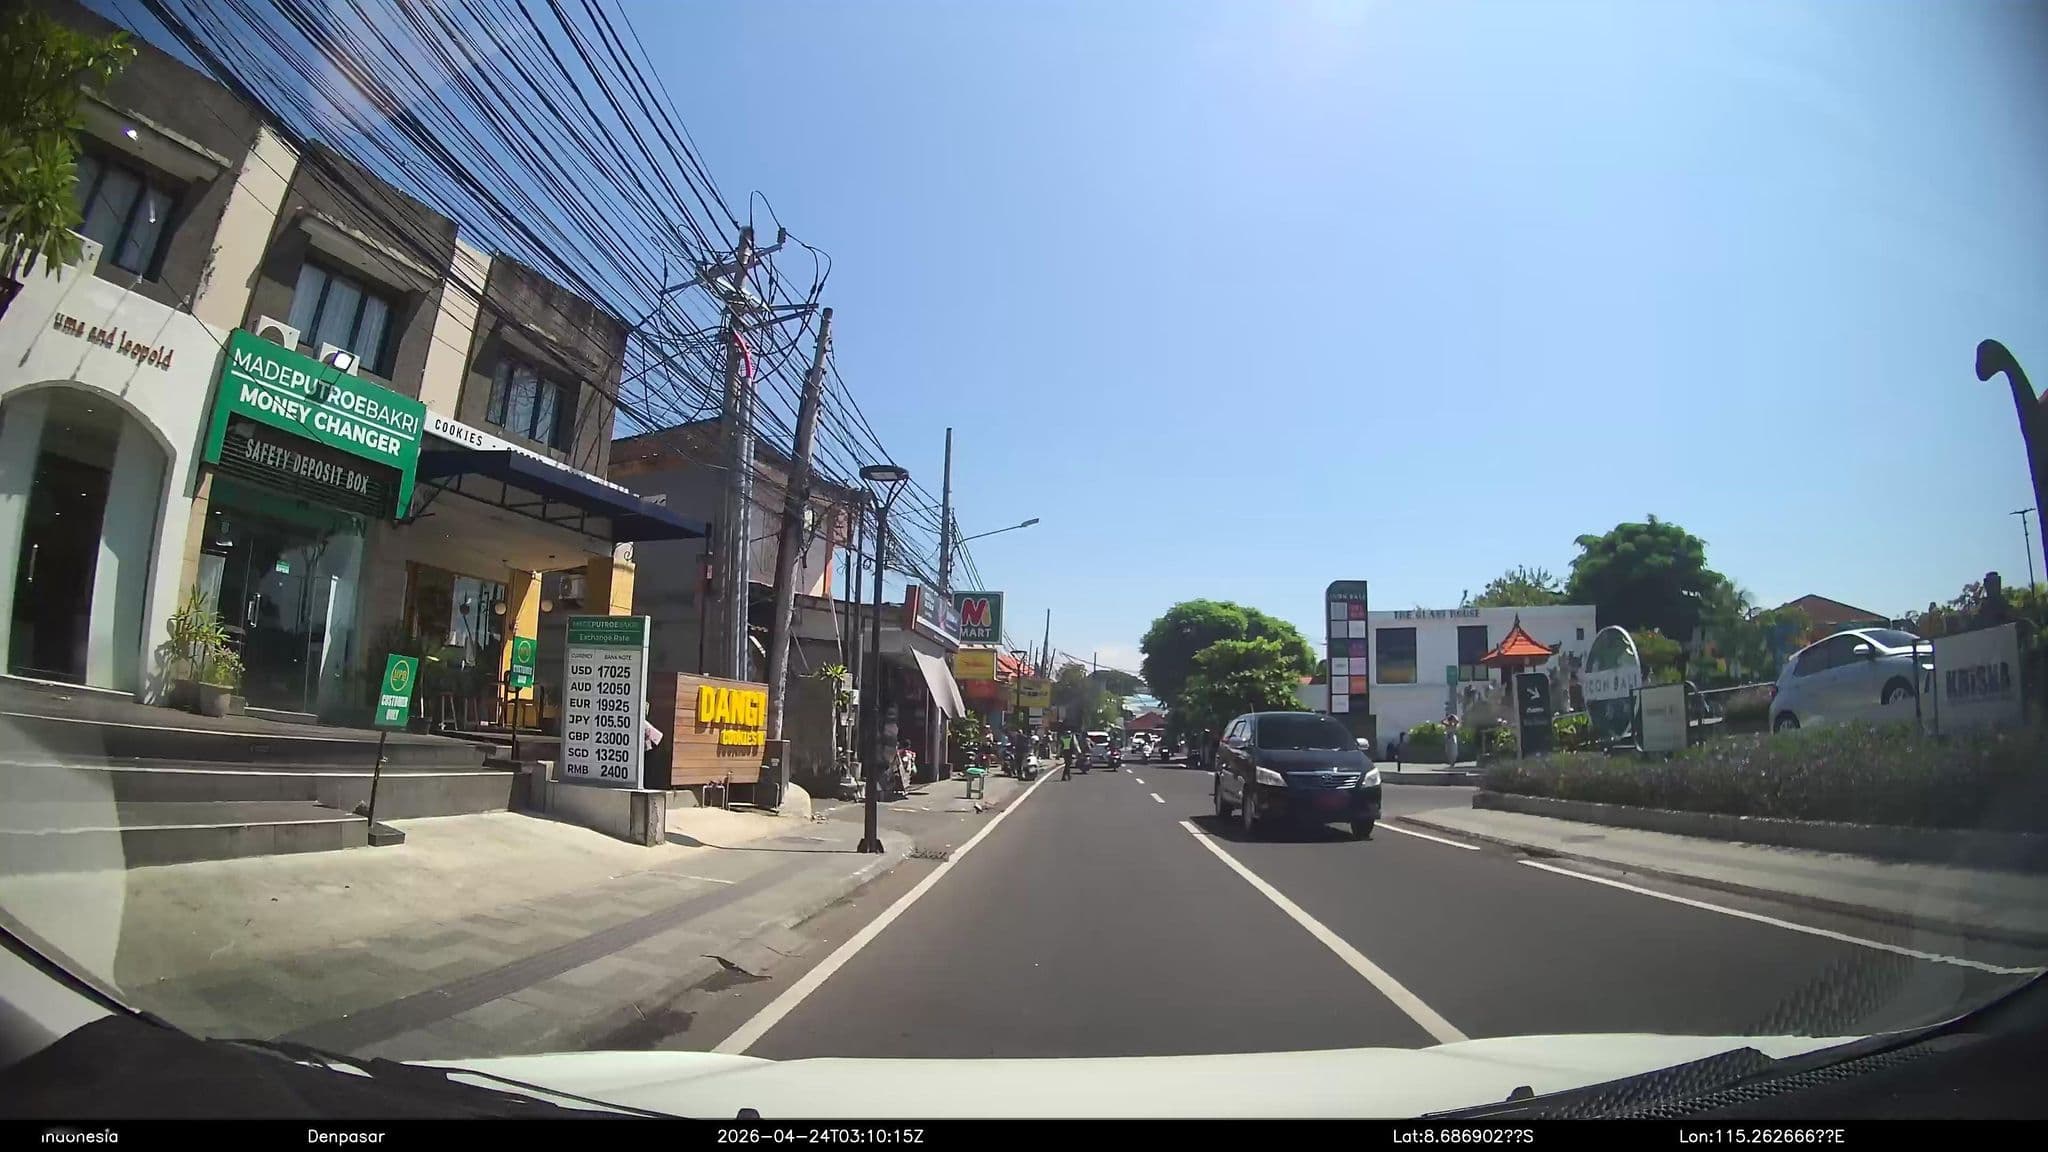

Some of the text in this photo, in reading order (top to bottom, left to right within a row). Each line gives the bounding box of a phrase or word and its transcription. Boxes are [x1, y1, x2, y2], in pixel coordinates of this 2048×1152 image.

[87, 326, 118, 349] and
[117, 330, 173, 371] leopold
[232, 348, 418, 434] MADEPUTROEBAKRI
[240, 384, 401, 456] MONEY CHANGER
[434, 418, 483, 447] COOKIES
[245, 438, 369, 494] SAFETY DEPOSIT BOX
[580, 634, 630, 643] Exchange Rate
[961, 628, 992, 638] MART
[571, 665, 631, 679] USD 17025
[570, 681, 630, 695] AUD 12050
[569, 698, 630, 713] EUR 19925
[568, 714, 631, 728] JPY 105.50
[568, 731, 630, 746] GBP 23000
[568, 747, 629, 762] SGD 13250
[567, 764, 628, 780] RMB 2400
